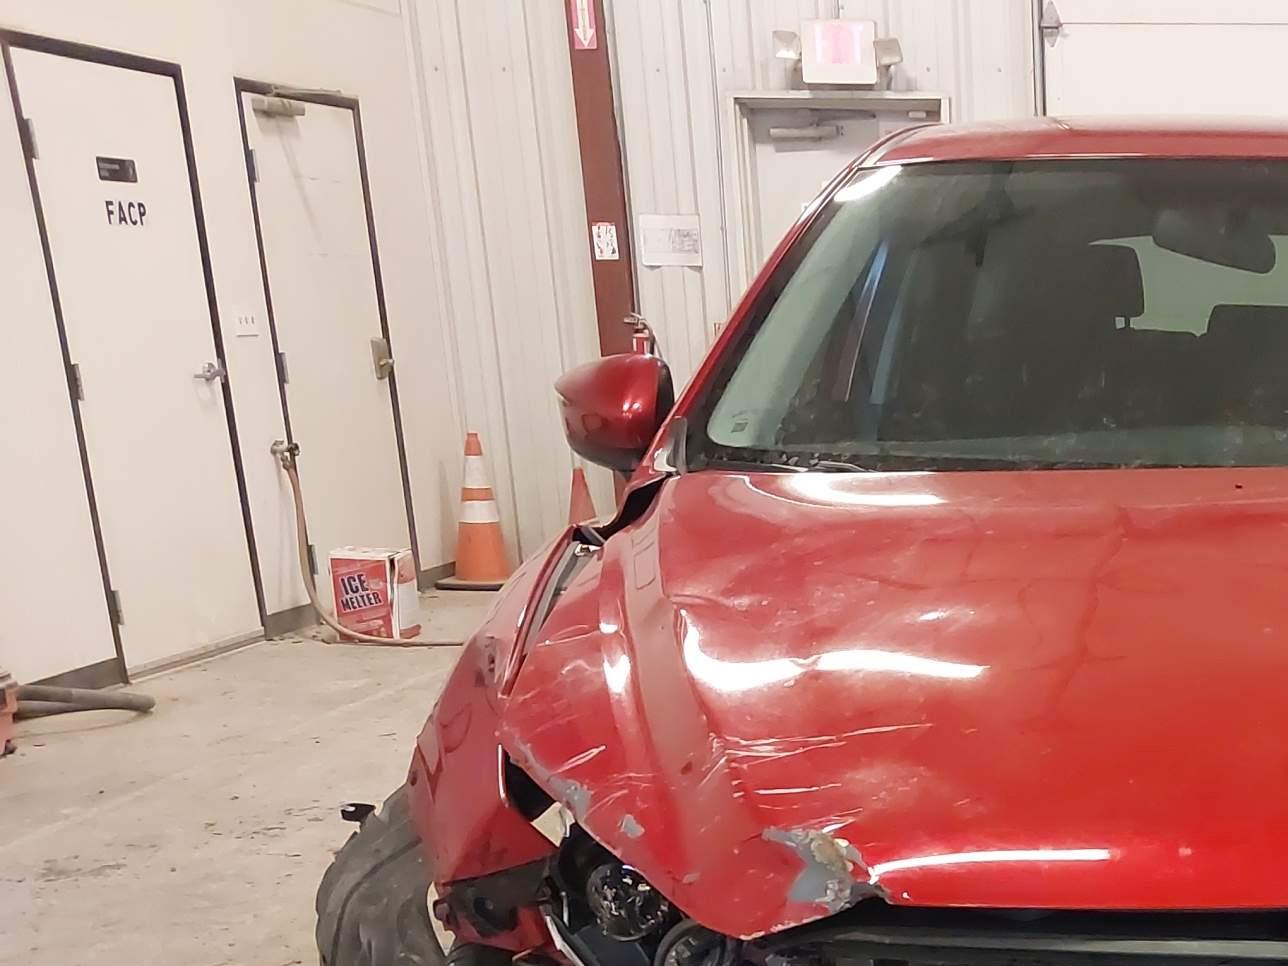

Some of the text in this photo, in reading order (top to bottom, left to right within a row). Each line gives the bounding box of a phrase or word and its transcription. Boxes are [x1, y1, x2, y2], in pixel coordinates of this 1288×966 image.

[105, 200, 146, 226] FACP
[340, 573, 369, 595] ICE
[340, 592, 382, 611] MELTER
